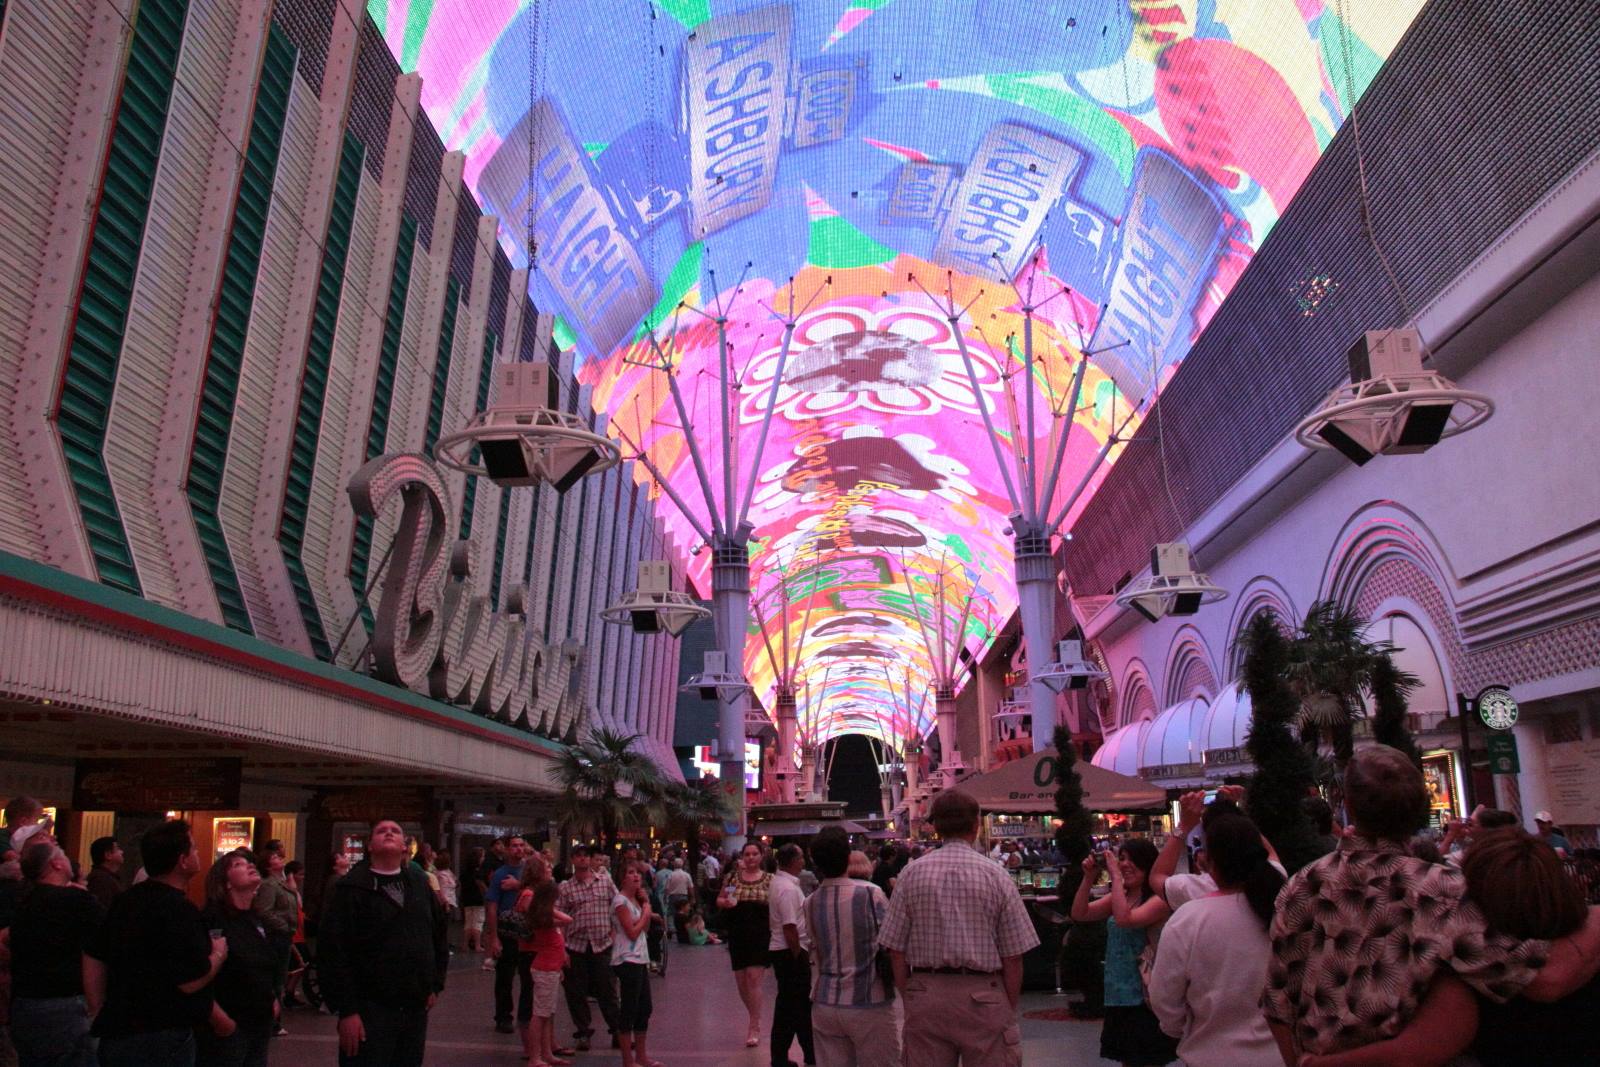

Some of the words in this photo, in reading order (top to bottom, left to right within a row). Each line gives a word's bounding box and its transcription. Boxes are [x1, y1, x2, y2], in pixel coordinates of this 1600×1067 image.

[704, 31, 776, 217] ASHBURY
[510, 144, 639, 326] HAIGHT
[951, 136, 1058, 272] ASHBURY
[1106, 196, 1196, 379] HAIGHT
[992, 826, 1024, 836] OXYGEN
[1009, 791, 1034, 800] Bar
[1037, 791, 1057, 800] an
